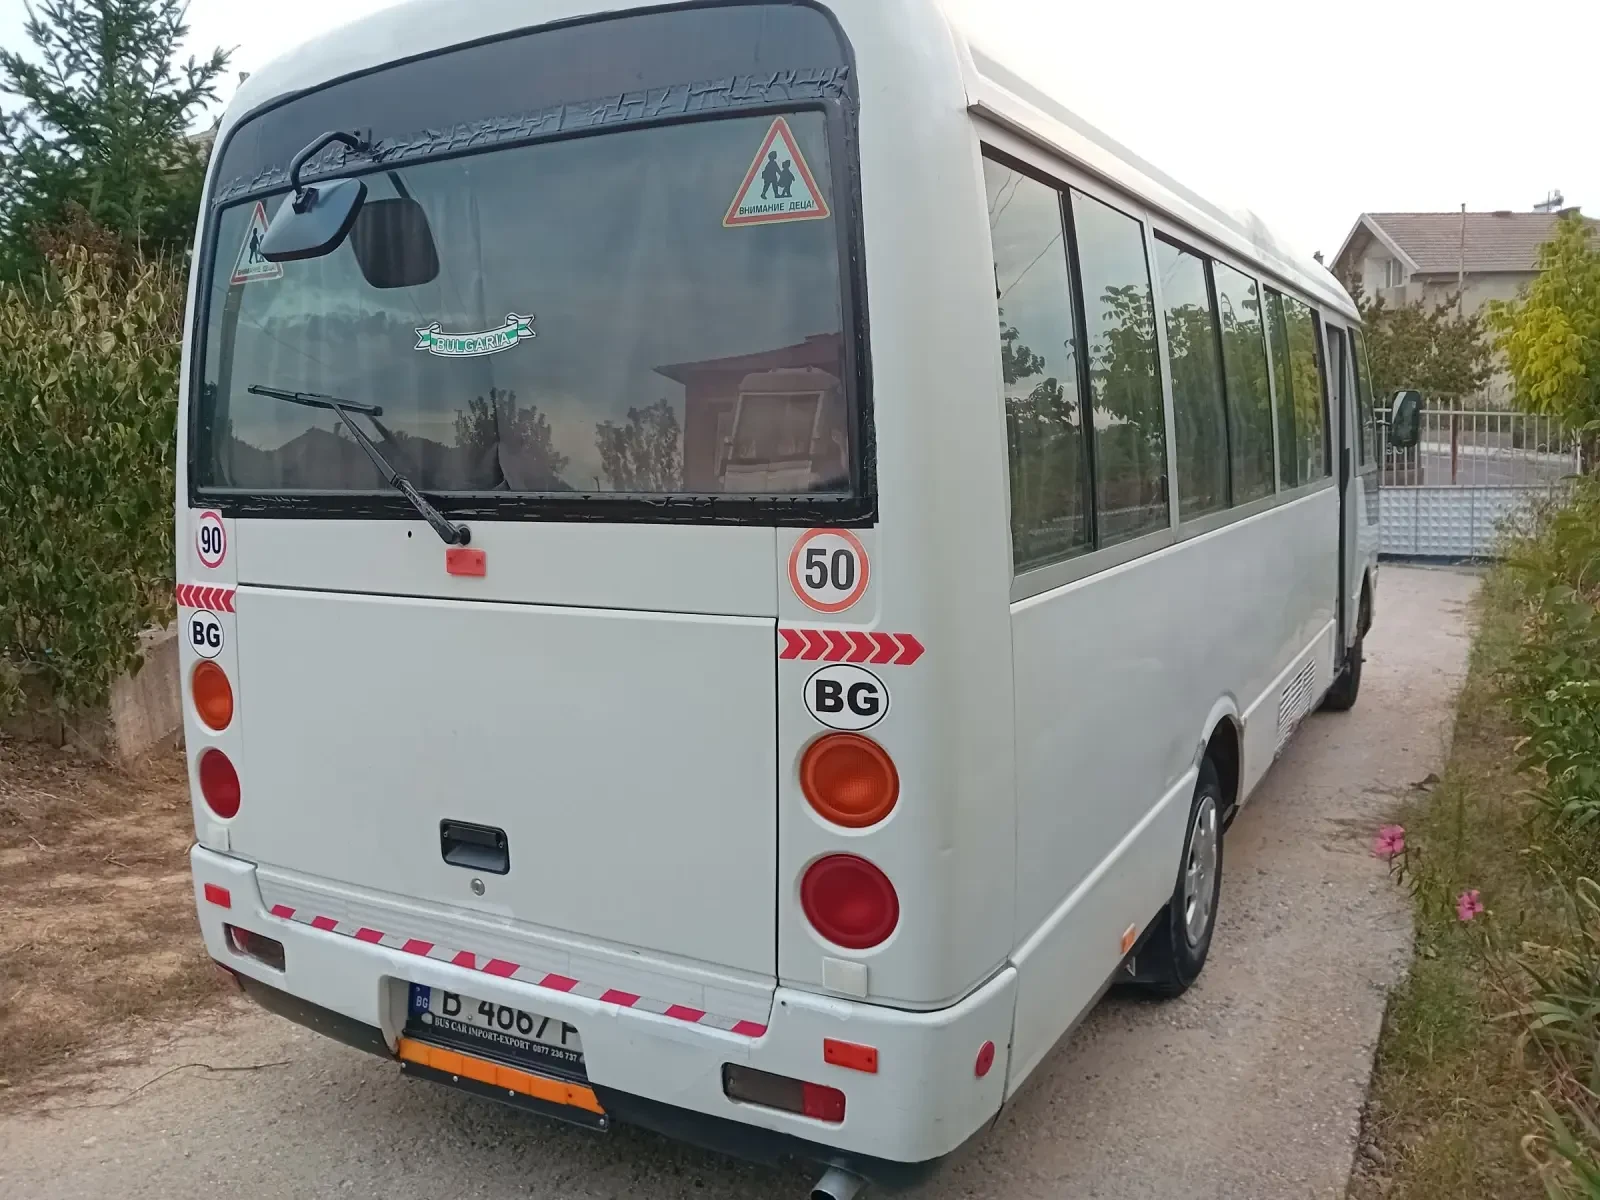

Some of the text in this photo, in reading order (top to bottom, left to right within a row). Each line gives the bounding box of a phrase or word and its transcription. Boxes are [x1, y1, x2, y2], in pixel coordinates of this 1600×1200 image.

[739, 199, 815, 215] ВНИМАНИЕ ДЕЦА!
[435, 331, 512, 352] BULGARIA
[201, 526, 222, 554] 90
[804, 548, 855, 591] 50
[192, 620, 221, 648] BG
[815, 679, 880, 716] BG
[415, 995, 429, 1009] BG
[434, 1016, 450, 1030] BUS
[450, 1020, 468, 1035] CAR
[468, 1026, 531, 1050] IMPORT-EXPORT
